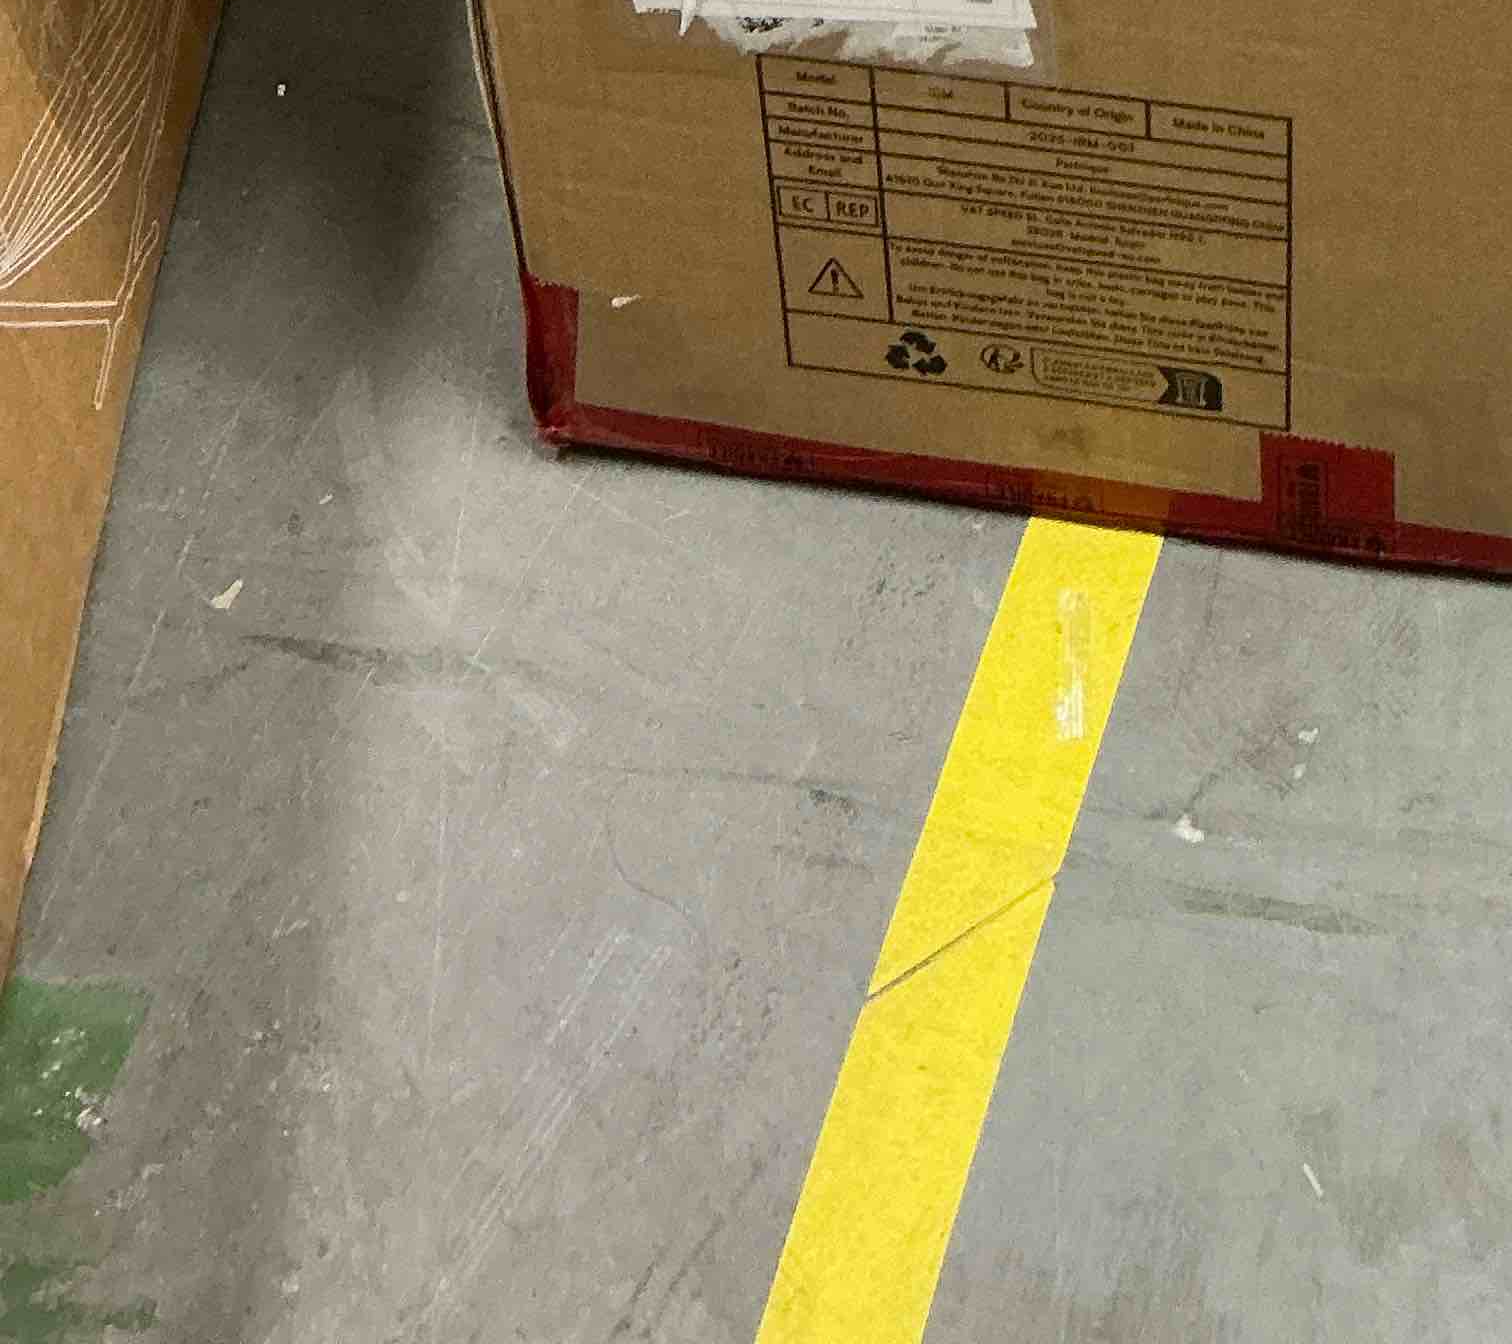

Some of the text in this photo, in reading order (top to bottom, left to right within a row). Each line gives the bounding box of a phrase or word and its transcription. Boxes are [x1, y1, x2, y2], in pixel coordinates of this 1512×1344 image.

[796, 70, 837, 85] Model
[788, 100, 826, 116] Batch
[1022, 97, 1074, 118] Country
[1094, 108, 1135, 124] Origin
[778, 124, 865, 145] Manufacturer
[1172, 116, 1266, 140] Made in China
[784, 145, 836, 164] Address
[808, 163, 843, 179] Email
[791, 195, 871, 220] EC REP
